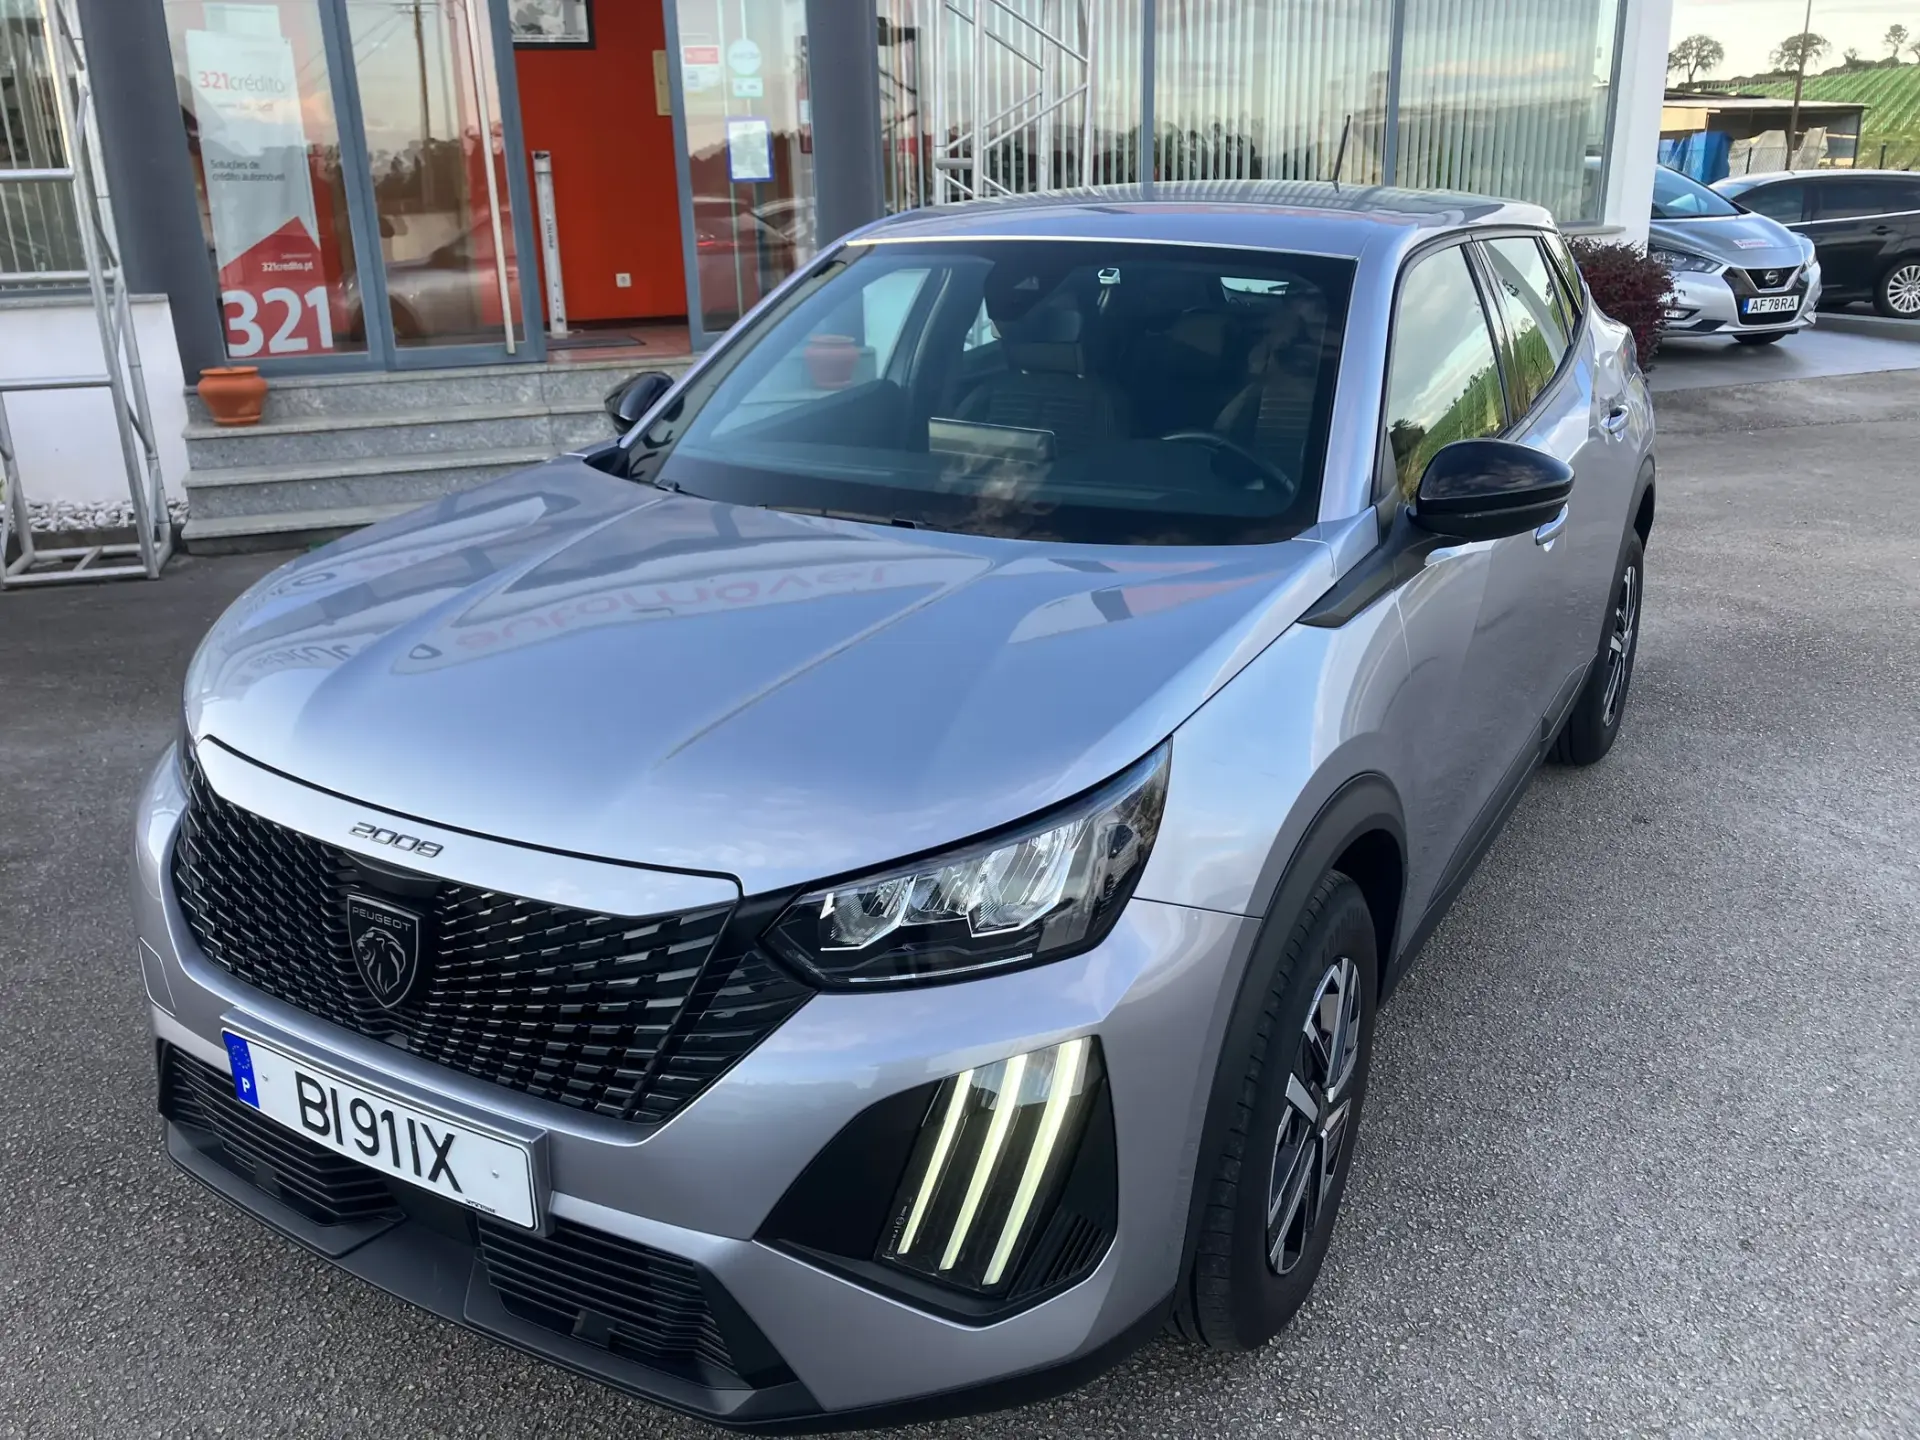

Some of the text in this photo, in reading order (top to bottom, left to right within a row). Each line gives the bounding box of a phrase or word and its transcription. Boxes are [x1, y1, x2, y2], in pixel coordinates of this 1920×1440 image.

[198, 71, 285, 93] 321crédito
[222, 286, 334, 357] 321
[348, 822, 444, 858] 2008
[352, 906, 411, 932] PEUGEOT
